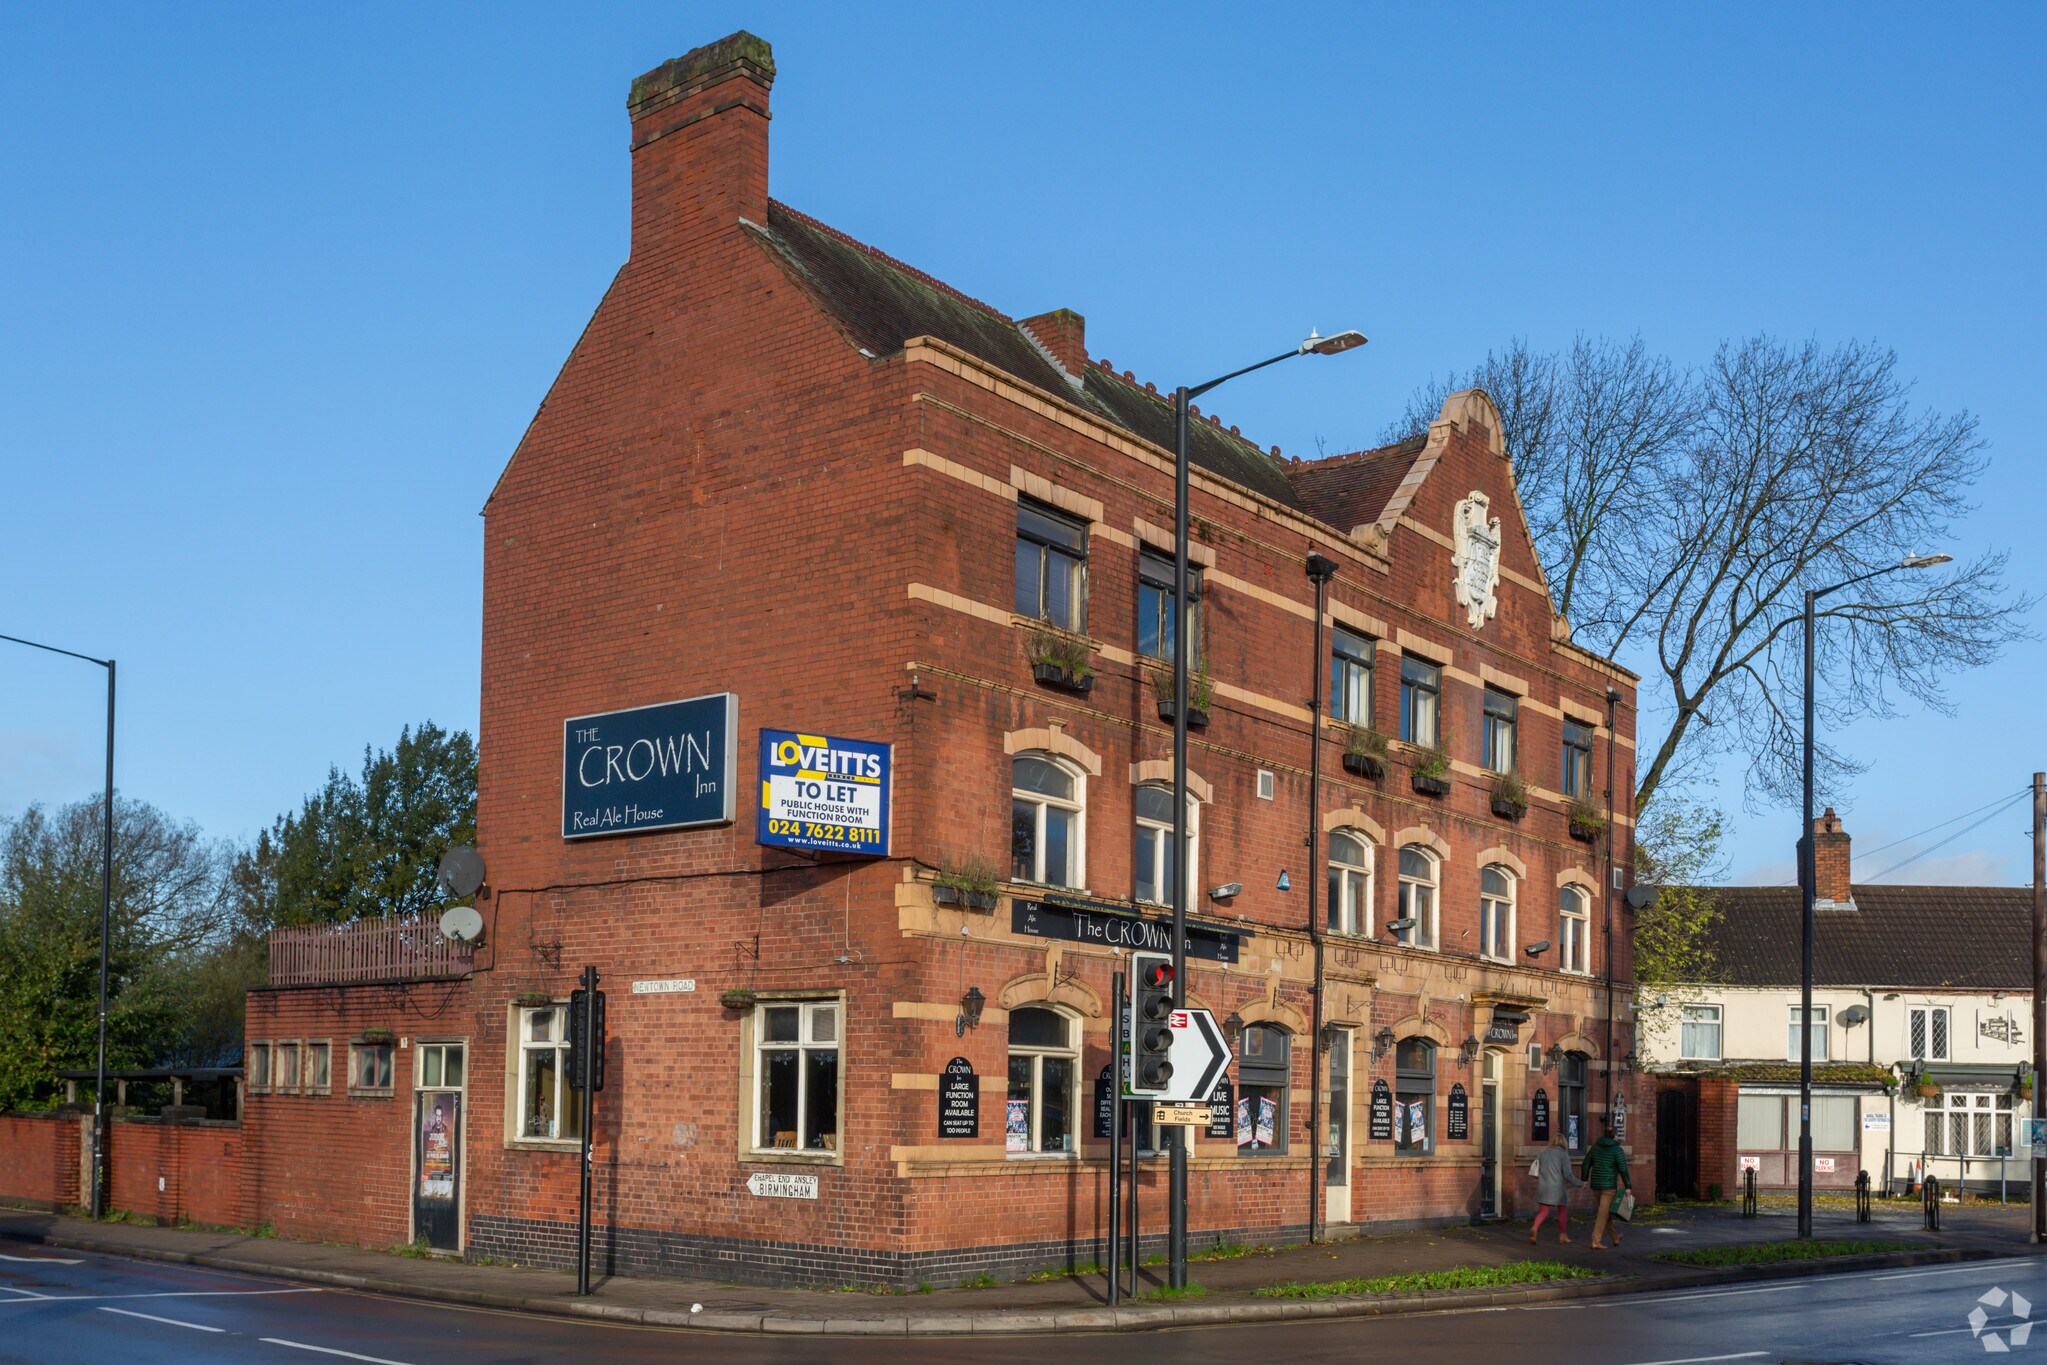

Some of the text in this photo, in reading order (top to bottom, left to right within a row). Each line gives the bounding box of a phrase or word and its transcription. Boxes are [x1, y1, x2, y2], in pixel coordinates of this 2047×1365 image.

[575, 727, 600, 744] THE
[579, 730, 710, 788] CROWN
[770, 740, 881, 778] LOVEITTS
[695, 773, 717, 799] Inn
[795, 780, 857, 803] TO LET
[780, 799, 869, 816] PUBLIC HOUSE WITH
[573, 803, 664, 831] Real Ale House
[787, 808, 863, 825] FUNCTION ROOM
[768, 819, 880, 844] 024 7622 8111
[788, 837, 861, 849] www.loveitts.co.uk
[1073, 912, 1102, 938] The
[1105, 918, 1172, 950] CROWN
[633, 980, 694, 992] NEWTOWN ROAD
[948, 1065, 971, 1074] CROWN
[950, 1082, 969, 1090] LARGE
[945, 1091, 974, 1099] FUNCTION
[1212, 1091, 1227, 1102] LIVE
[944, 1109, 975, 1117] AVAILABLE
[754, 1174, 817, 1185] CHAPEL END ANSLEY
[759, 1183, 811, 1198] BIRMINGHAM
